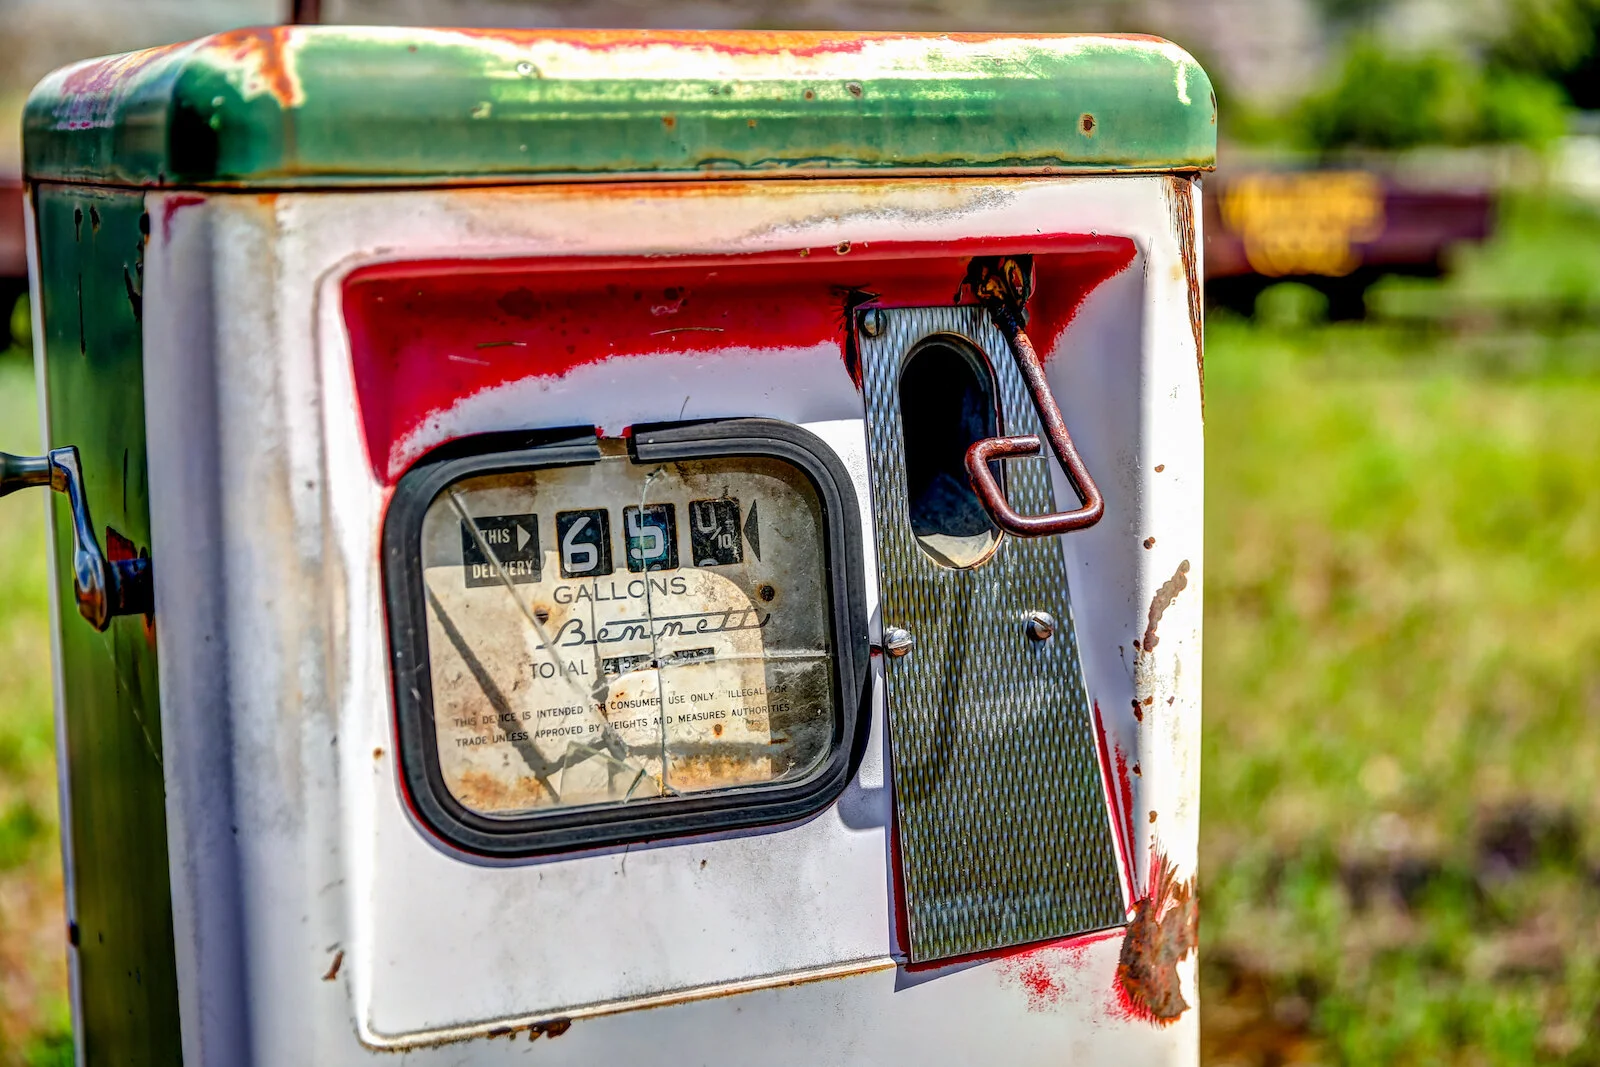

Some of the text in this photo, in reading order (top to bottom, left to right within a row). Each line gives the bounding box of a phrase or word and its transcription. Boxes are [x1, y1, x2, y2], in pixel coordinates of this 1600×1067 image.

[479, 528, 511, 544] THIS
[562, 516, 599, 573] 6
[627, 509, 665, 560] 5
[472, 560, 533, 579] DELVERY
[553, 576, 688, 605] GALLONS
[536, 605, 771, 650] Bennett
[453, 716, 477, 728] THIS
[482, 711, 516, 725] DEVICE
[522, 710, 531, 721] IS
[536, 704, 584, 718] INTENDED
[610, 697, 661, 711] CONSUMER
[668, 694, 686, 705] USE
[728, 687, 765, 699] ILLEGAL
[769, 683, 788, 694] OR
[455, 735, 487, 748] TRADE
[492, 731, 529, 744] UNLESS
[534, 726, 583, 740] APPROVED
[588, 723, 600, 733] BY
[678, 710, 726, 724] MEASURES
[731, 703, 791, 717] AUTHORITIES
